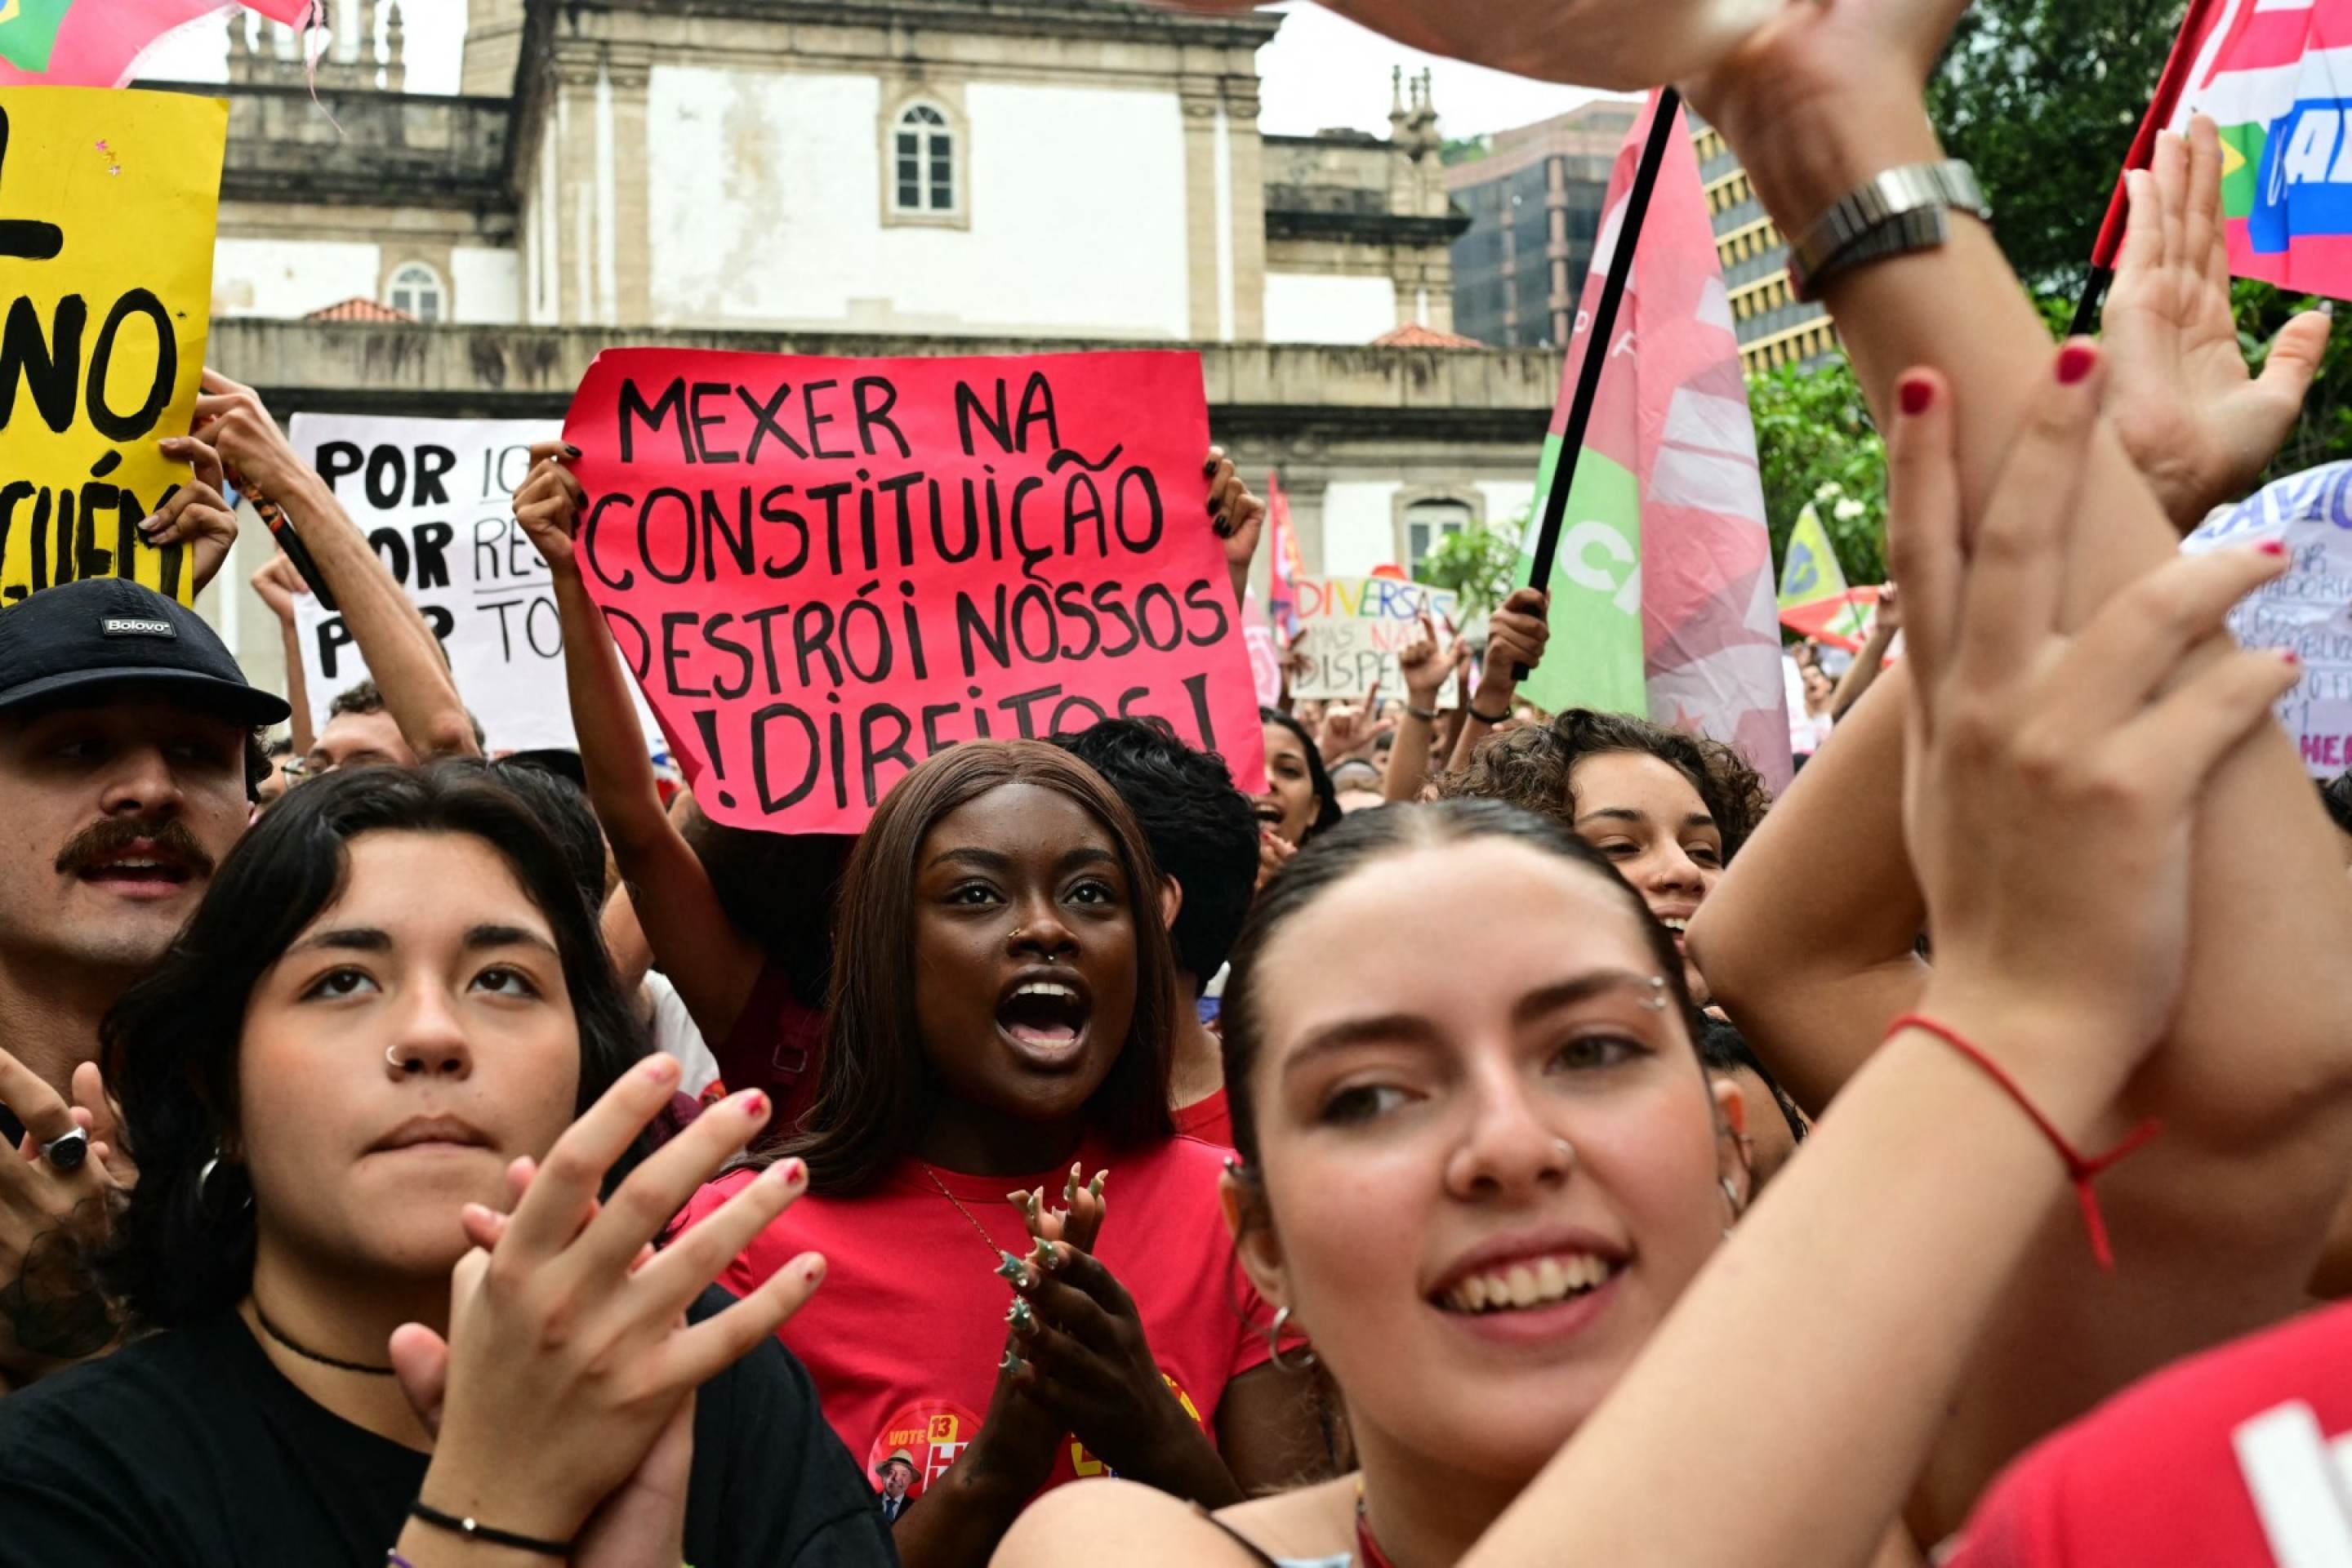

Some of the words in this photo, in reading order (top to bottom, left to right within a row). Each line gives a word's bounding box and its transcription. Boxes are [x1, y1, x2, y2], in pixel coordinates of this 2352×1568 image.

[618, 376, 911, 465] MEXER
[955, 371, 1060, 457] NA
[316, 442, 456, 510] POR
[369, 522, 454, 590] OR
[316, 605, 455, 679] PR
[956, 579, 1229, 677] NOSSOS
[889, 1429, 926, 1446] VOTE
[931, 1417, 951, 1438] 13
